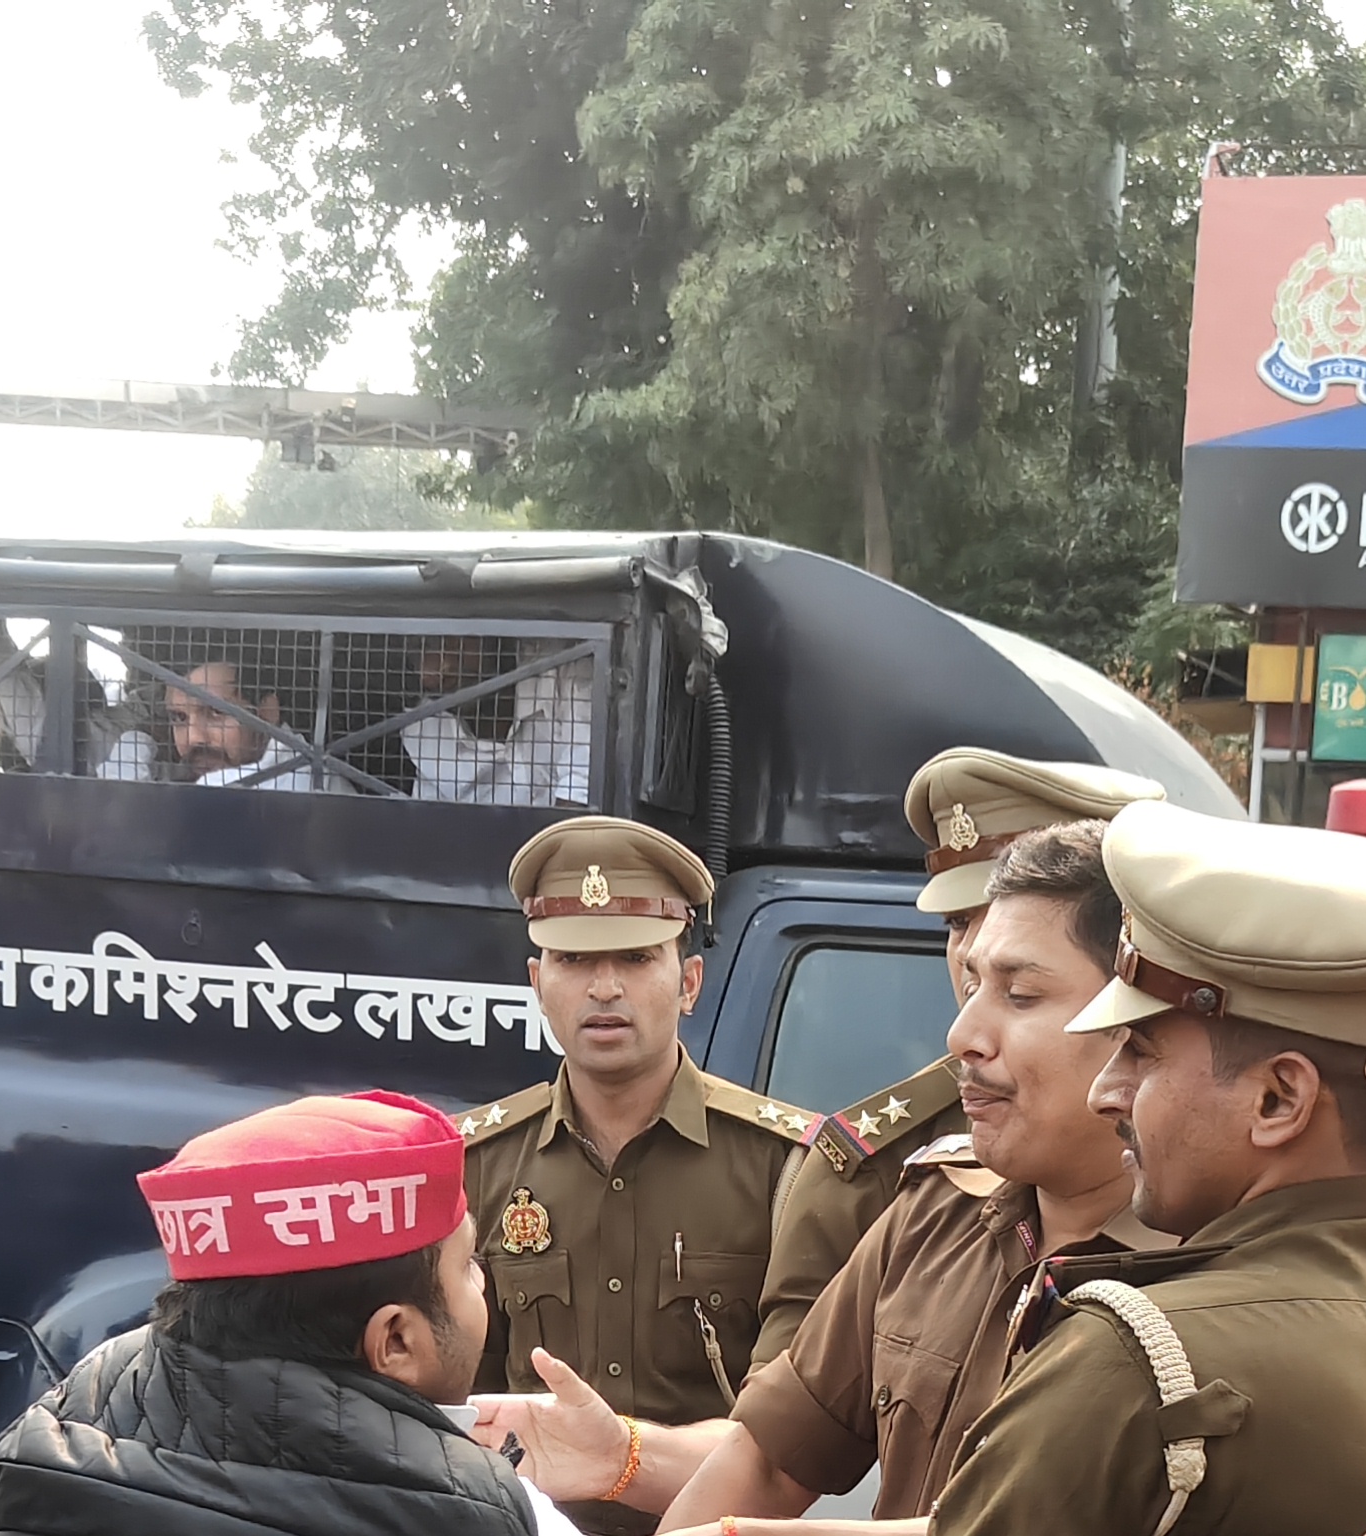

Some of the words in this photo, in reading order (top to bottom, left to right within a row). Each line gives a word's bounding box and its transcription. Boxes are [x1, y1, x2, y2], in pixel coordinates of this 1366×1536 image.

[23, 931, 345, 1033] कमिश्नरेट
[150, 1195, 233, 1256] छात्र
[254, 1173, 428, 1247] सभा
